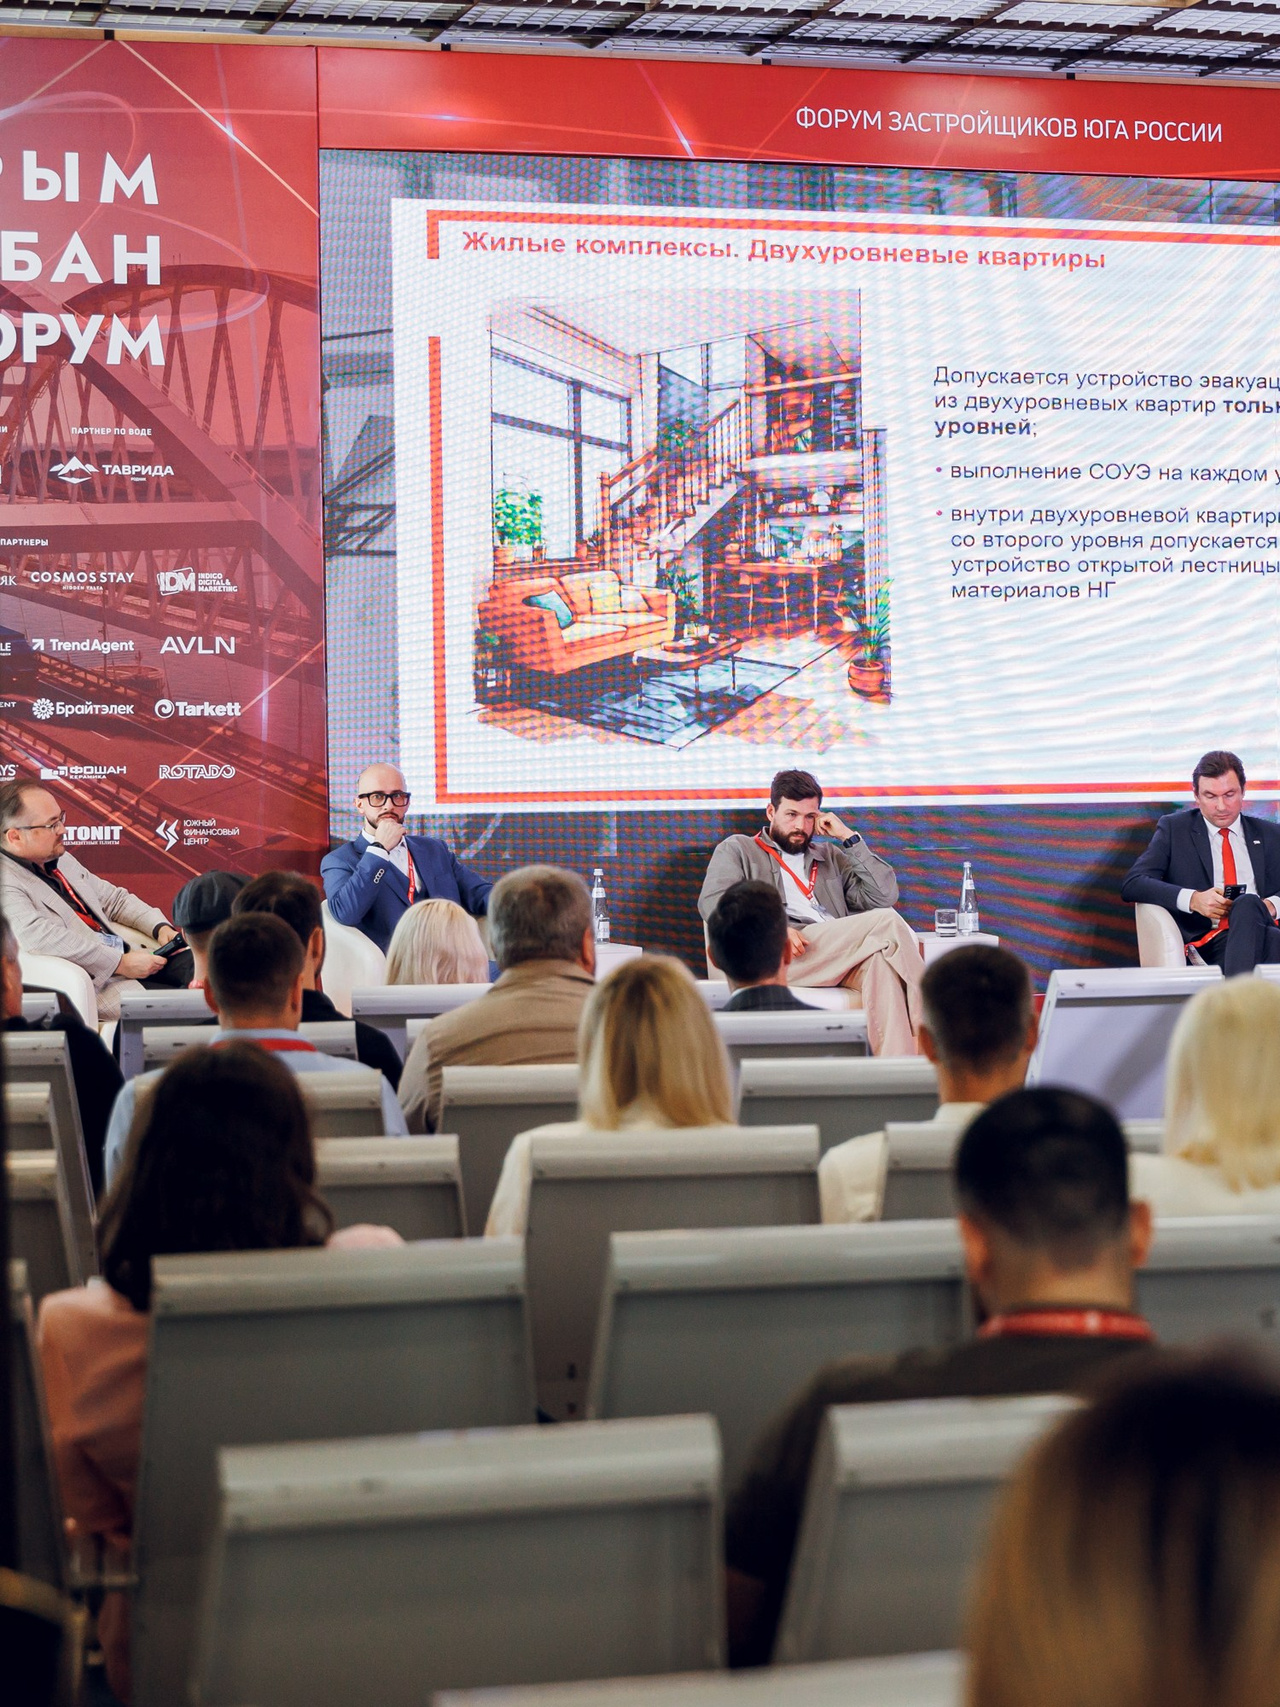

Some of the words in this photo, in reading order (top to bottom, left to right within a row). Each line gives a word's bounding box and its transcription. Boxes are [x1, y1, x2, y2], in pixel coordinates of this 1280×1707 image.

[796, 106, 881, 130] ФОРУМ
[889, 109, 1077, 139] ЗАСТРОЙЩИКОВ
[1084, 119, 1129, 139] ЮГА
[1135, 121, 1222, 142] РОССИИ
[0, 150, 159, 204] ЫМ
[463, 231, 565, 253] Жилые
[576, 239, 738, 257] комплексы.
[748, 239, 968, 264] Двухуровневые
[978, 251, 1105, 272] квартиры
[934, 366, 1068, 388] Допускается
[1076, 371, 1193, 390] устройство
[935, 396, 957, 408] из
[964, 396, 1128, 413] двухуровневых
[1136, 399, 1216, 416] квартир
[71, 427, 112, 435] ПАРТНЕР
[128, 428, 152, 436] ВОДЕ
[934, 418, 1036, 438] уровней;
[102, 465, 174, 477] ТАВРИДА
[951, 466, 1081, 479] выполнение
[1089, 463, 1150, 480] СОУЭ
[1159, 468, 1182, 480] на
[1191, 468, 1267, 483] каждом
[952, 509, 1023, 526] внутри
[1030, 507, 1189, 526] двухуровневой
[0, 538, 48, 546] ПАРТНЕРЫ
[951, 535, 975, 547] со
[983, 535, 1063, 551] второго
[1071, 535, 1143, 552] уровня
[1150, 536, 1277, 552] допускается
[951, 556, 1070, 576] устройство
[1078, 557, 1173, 577] открытой
[30, 572, 96, 583] COSMOS
[100, 572, 134, 583] STAY
[159, 572, 196, 592] IDM
[952, 585, 1080, 601] материалов
[1088, 581, 1116, 598] НГ
[50, 639, 134, 654] TrendAgent
[160, 636, 235, 654] AVLN
[56, 701, 134, 717] Брайтэлек
[175, 702, 241, 716] Tarkett
[70, 765, 126, 775] ФОШАН
[159, 764, 235, 779] ROTADO
[183, 818, 216, 827] ЮЖНЫЙ
[183, 827, 240, 836] ФИНАНСОВЫЙ
[183, 837, 209, 846] ЦЕНТР
